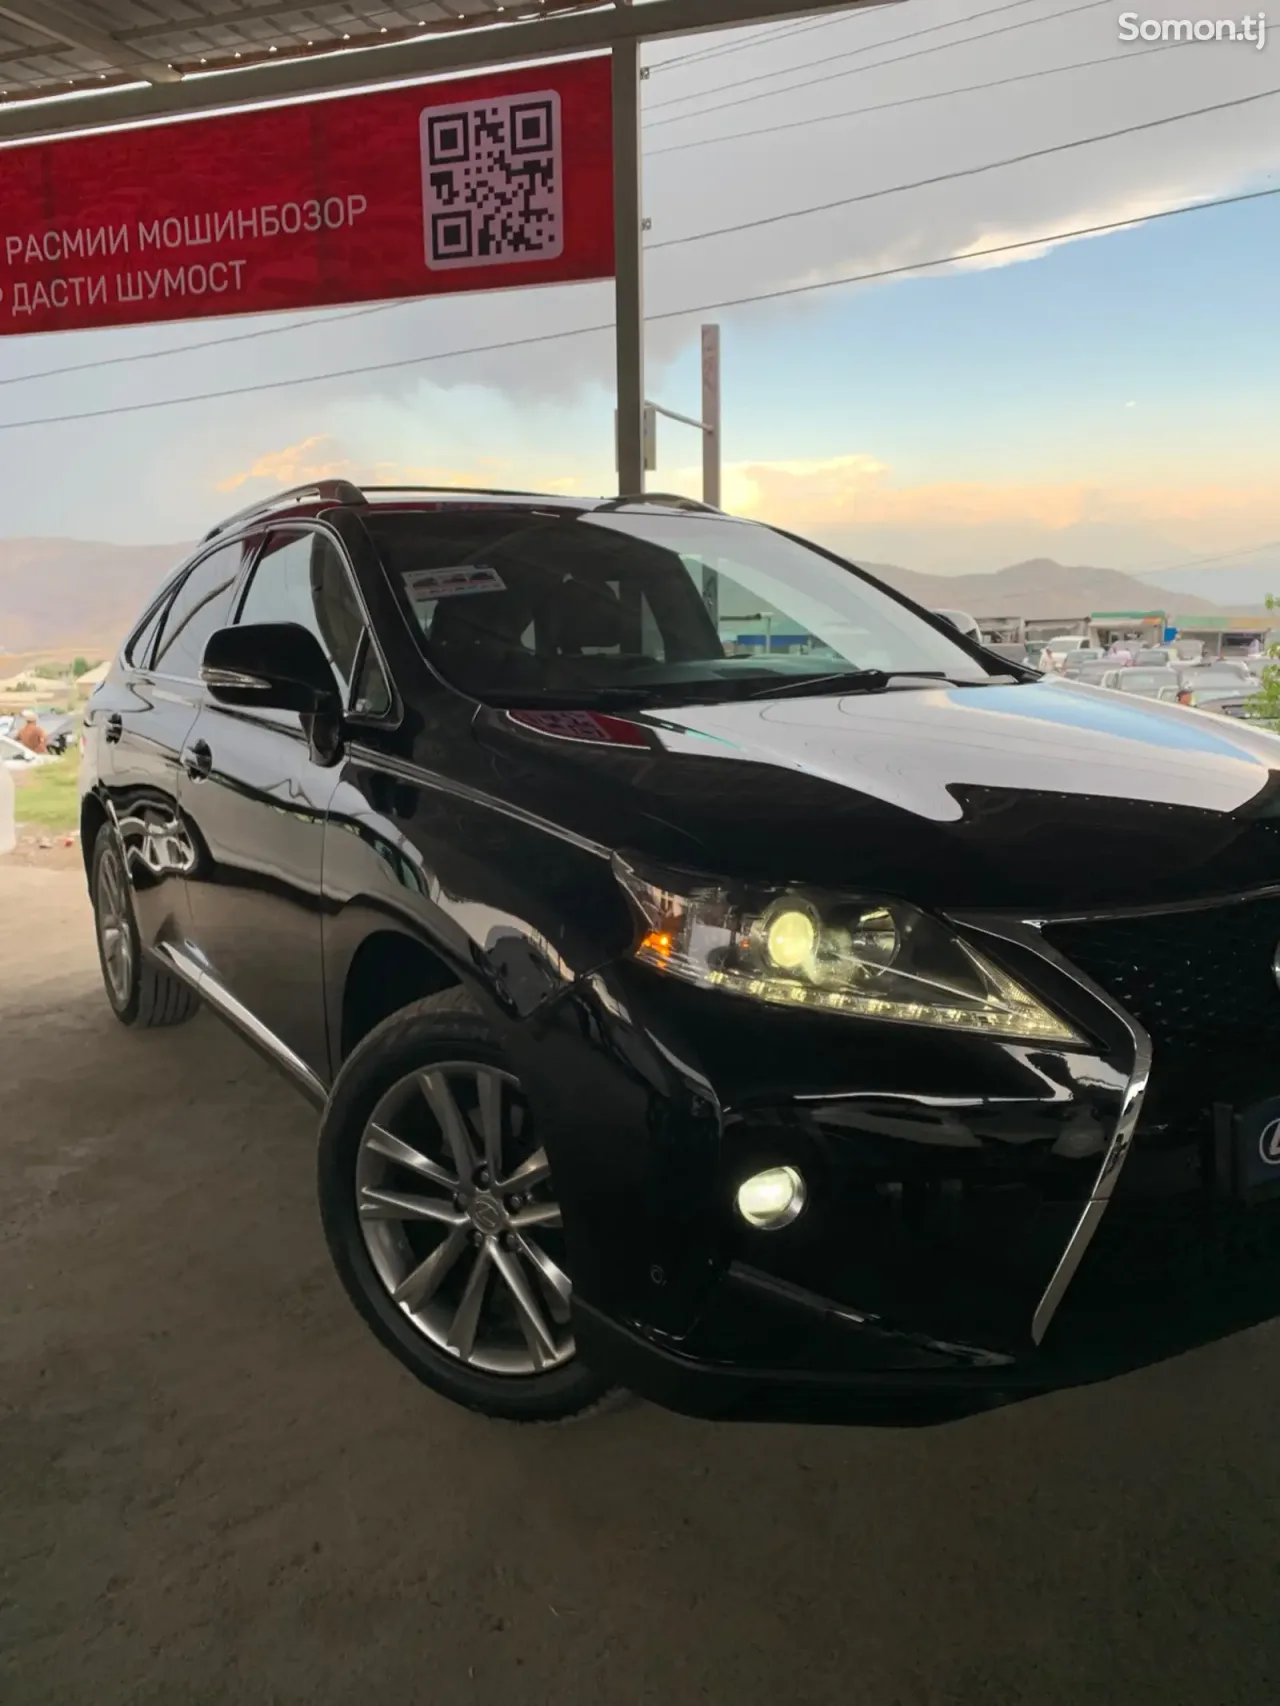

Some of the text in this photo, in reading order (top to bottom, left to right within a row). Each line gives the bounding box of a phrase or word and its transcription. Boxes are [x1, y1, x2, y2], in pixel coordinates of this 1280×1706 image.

[5, 194, 367, 266] РАСМИИ МОШИНБОЗОР
[11, 259, 247, 317] ДАСТИ ШУМОСТ
